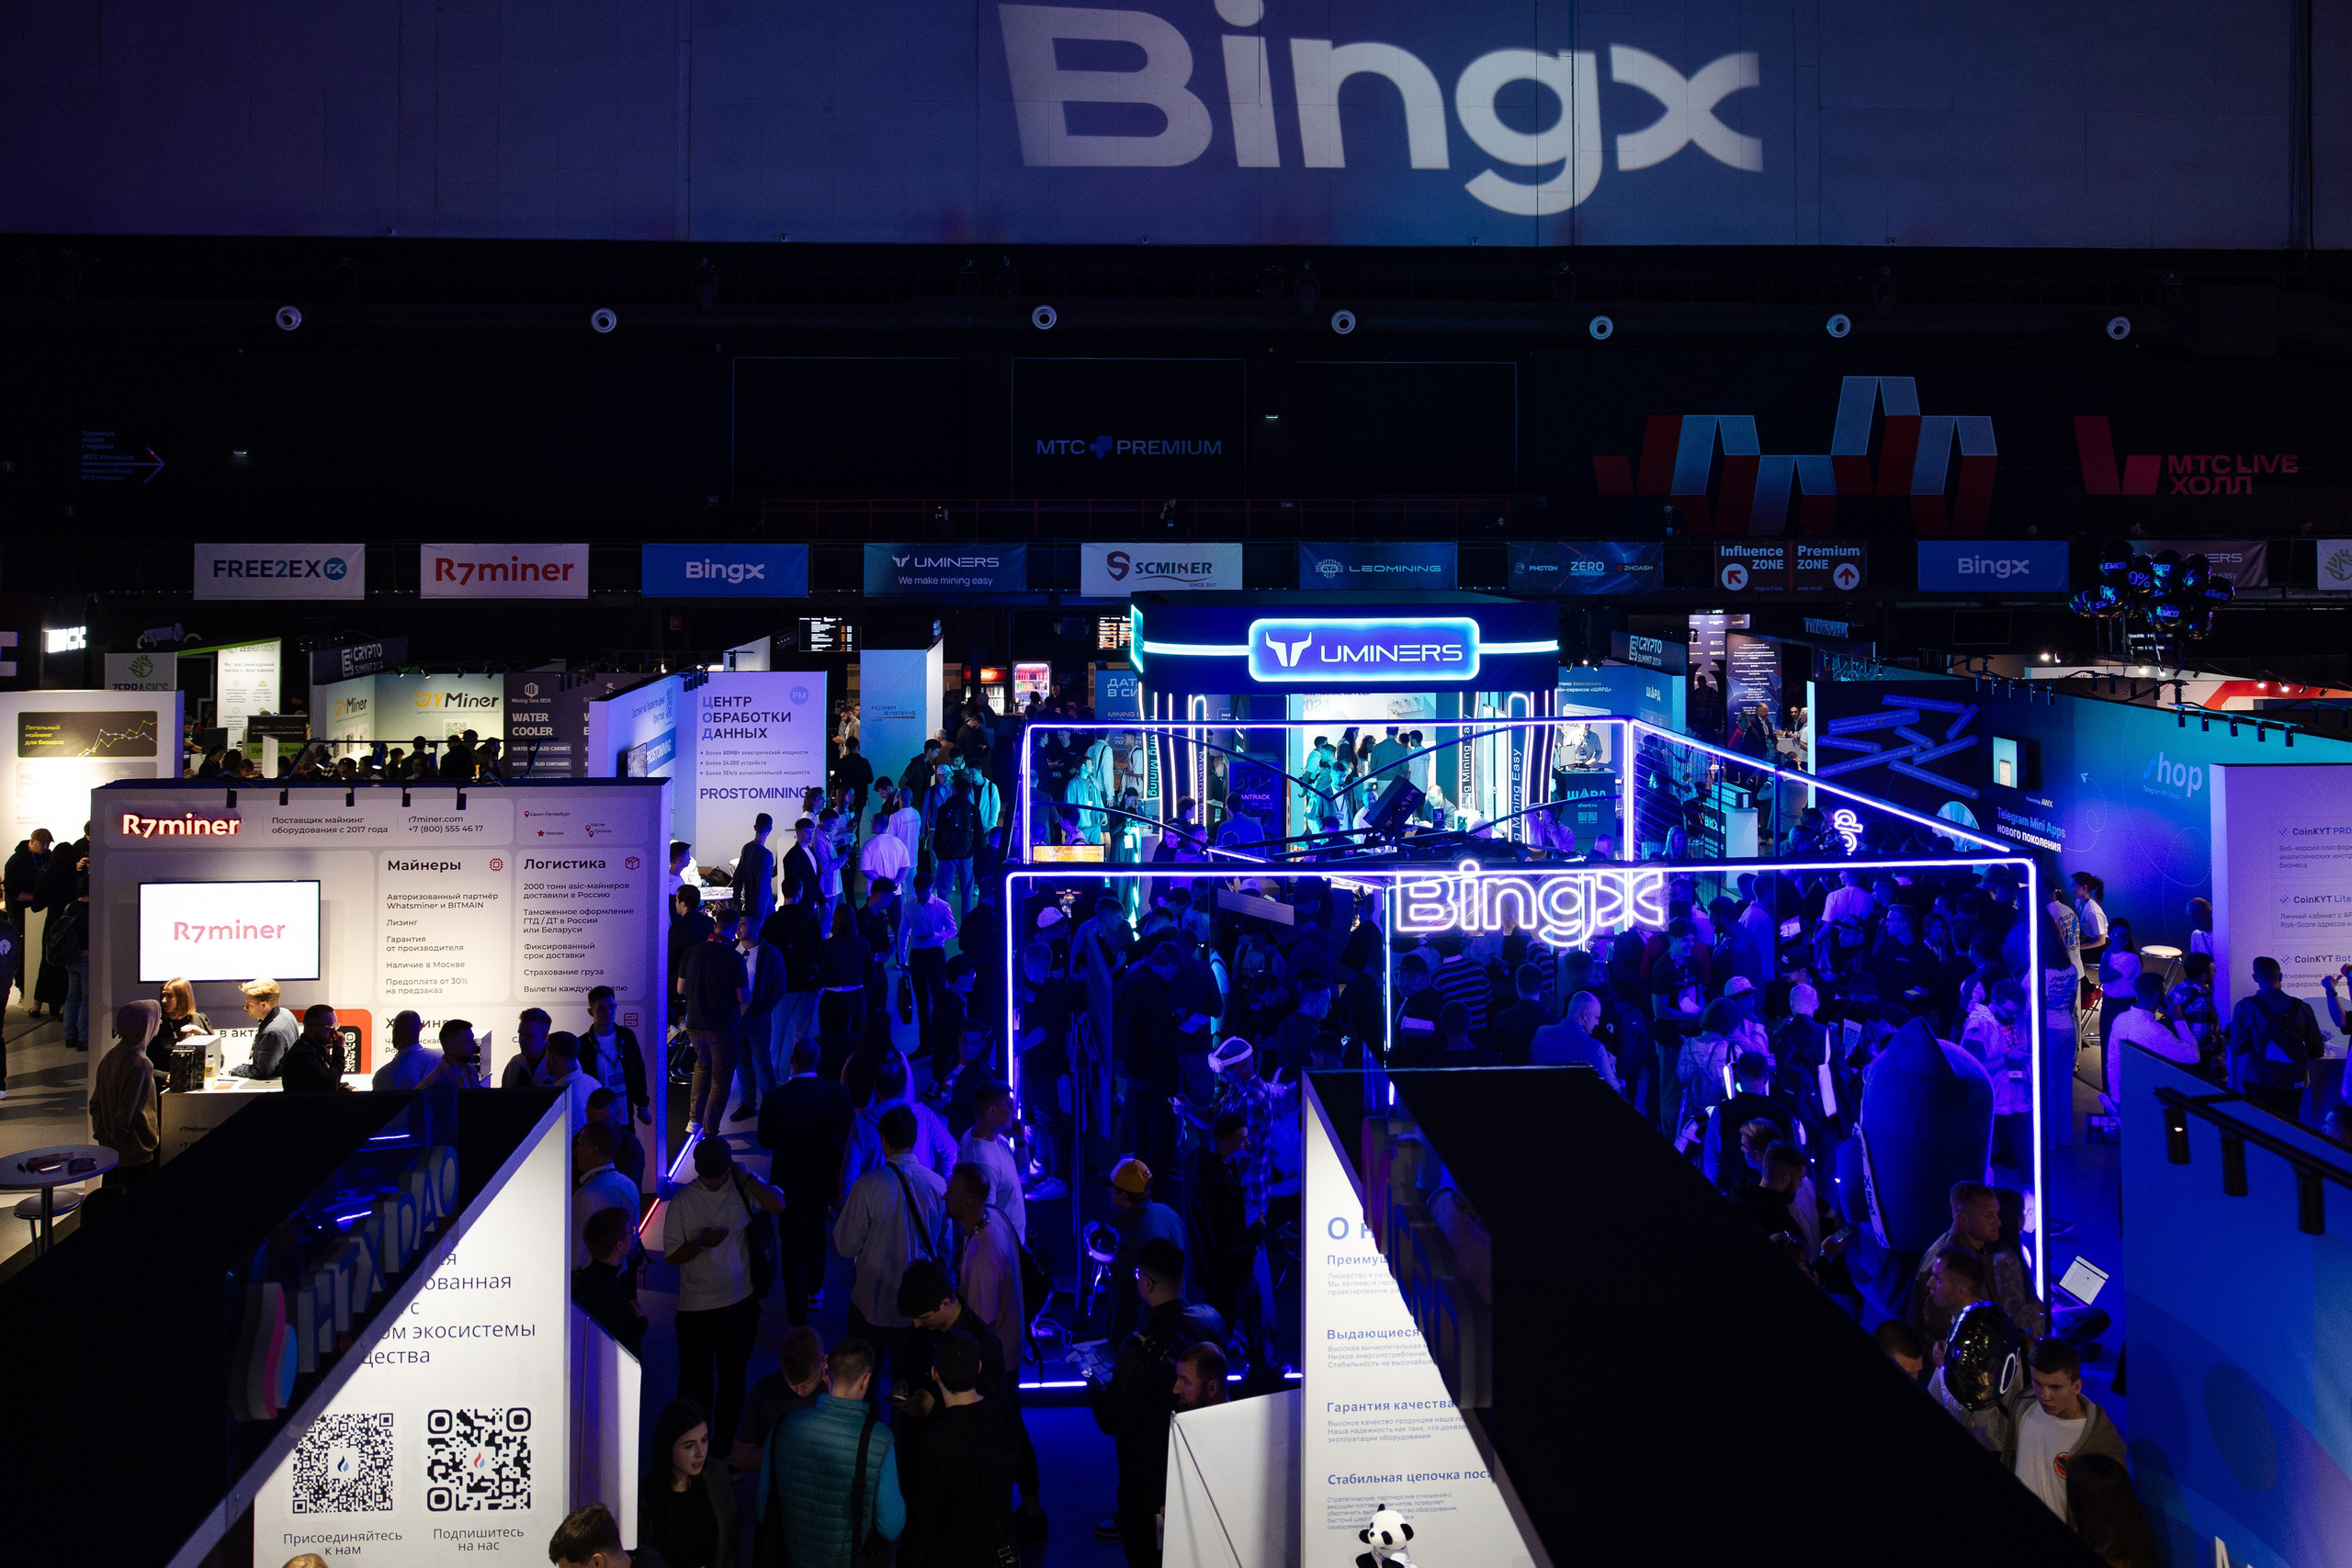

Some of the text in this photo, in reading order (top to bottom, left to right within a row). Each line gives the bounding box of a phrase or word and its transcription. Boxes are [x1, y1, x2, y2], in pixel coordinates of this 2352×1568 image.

[1116, 440, 1223, 456] PREMIUM
[2236, 454, 2300, 474] LIVE
[2169, 476, 2253, 495] ХОЛЛ
[1720, 545, 1784, 557] Influence
[1797, 545, 1860, 557] Premium
[913, 557, 1000, 568] UMINERS
[1135, 561, 1213, 575] SCMINER
[1570, 561, 1605, 571] ZERO
[1751, 559, 1784, 570] ZONE
[1797, 559, 1829, 570] ZONE
[212, 559, 322, 579] FREE2EX
[435, 556, 574, 586] R7miner
[1349, 564, 1442, 573] LEOMINING
[898, 576, 994, 588] We make mining easy
[1638, 637, 1663, 654] CRYPTO
[352, 643, 383, 662] CRYPTO
[1320, 644, 1464, 663] UMINERS
[702, 696, 752, 709] ЦЕНТР
[512, 713, 549, 722] WATER
[702, 711, 792, 723] ОБРАБОТКИ
[512, 727, 553, 736] COOLER
[701, 728, 768, 741] ДАННЫХ
[1462, 745, 1473, 781] Mining
[1511, 748, 1522, 781] Easy
[121, 812, 243, 839] R7miner
[272, 816, 365, 826] Поставщик майнинг
[1996, 807, 2066, 840] Telegram Mini Apps
[271, 826, 337, 835] оборудования
[420, 825, 443, 833] (800)
[2292, 827, 2352, 836] CoinKYT PRO
[1996, 823, 2062, 853] нового поколения
[388, 859, 461, 873] Майнеры
[524, 858, 606, 870] Логистика
[568, 882, 630, 890] asic-майнеров
[387, 893, 460, 901] Авторизованный
[578, 891, 611, 899] Россию
[2293, 895, 2352, 904] CoinKYT Lite
[387, 901, 438, 909] Whatsminer
[580, 908, 634, 916] оформление
[2309, 911, 2336, 919] кабинет
[174, 919, 286, 943] R7miner
[541, 926, 582, 935] Беларуси
[398, 944, 464, 953] производителя
[524, 942, 595, 951] Фиксированный
[2294, 954, 2352, 964] CoinKYT Bot
[524, 968, 579, 976] Страхование
[386, 978, 438, 987] Предоплата
[413, 1324, 536, 1339] экосистемы
[1327, 1328, 1419, 1341] Выдающиеся
[1328, 1343, 1422, 1353] Высокая вычислительная
[1355, 1350, 1427, 1360] энергопотребление
[1328, 1360, 1380, 1369] Стабильность
[1327, 1399, 1454, 1415] Гарантия качества
[1361, 1418, 1394, 1427] качество
[1395, 1417, 1433, 1427] продукции
[1328, 1433, 1431, 1444] эксплуатации оборудования
[1328, 1471, 1460, 1485] Стабильная цепочка
[283, 1532, 402, 1546] Присоединяйтесь
[433, 1527, 525, 1541] Подпишитесь
[324, 1544, 362, 1556] к нам
[458, 1540, 501, 1551] на нас
